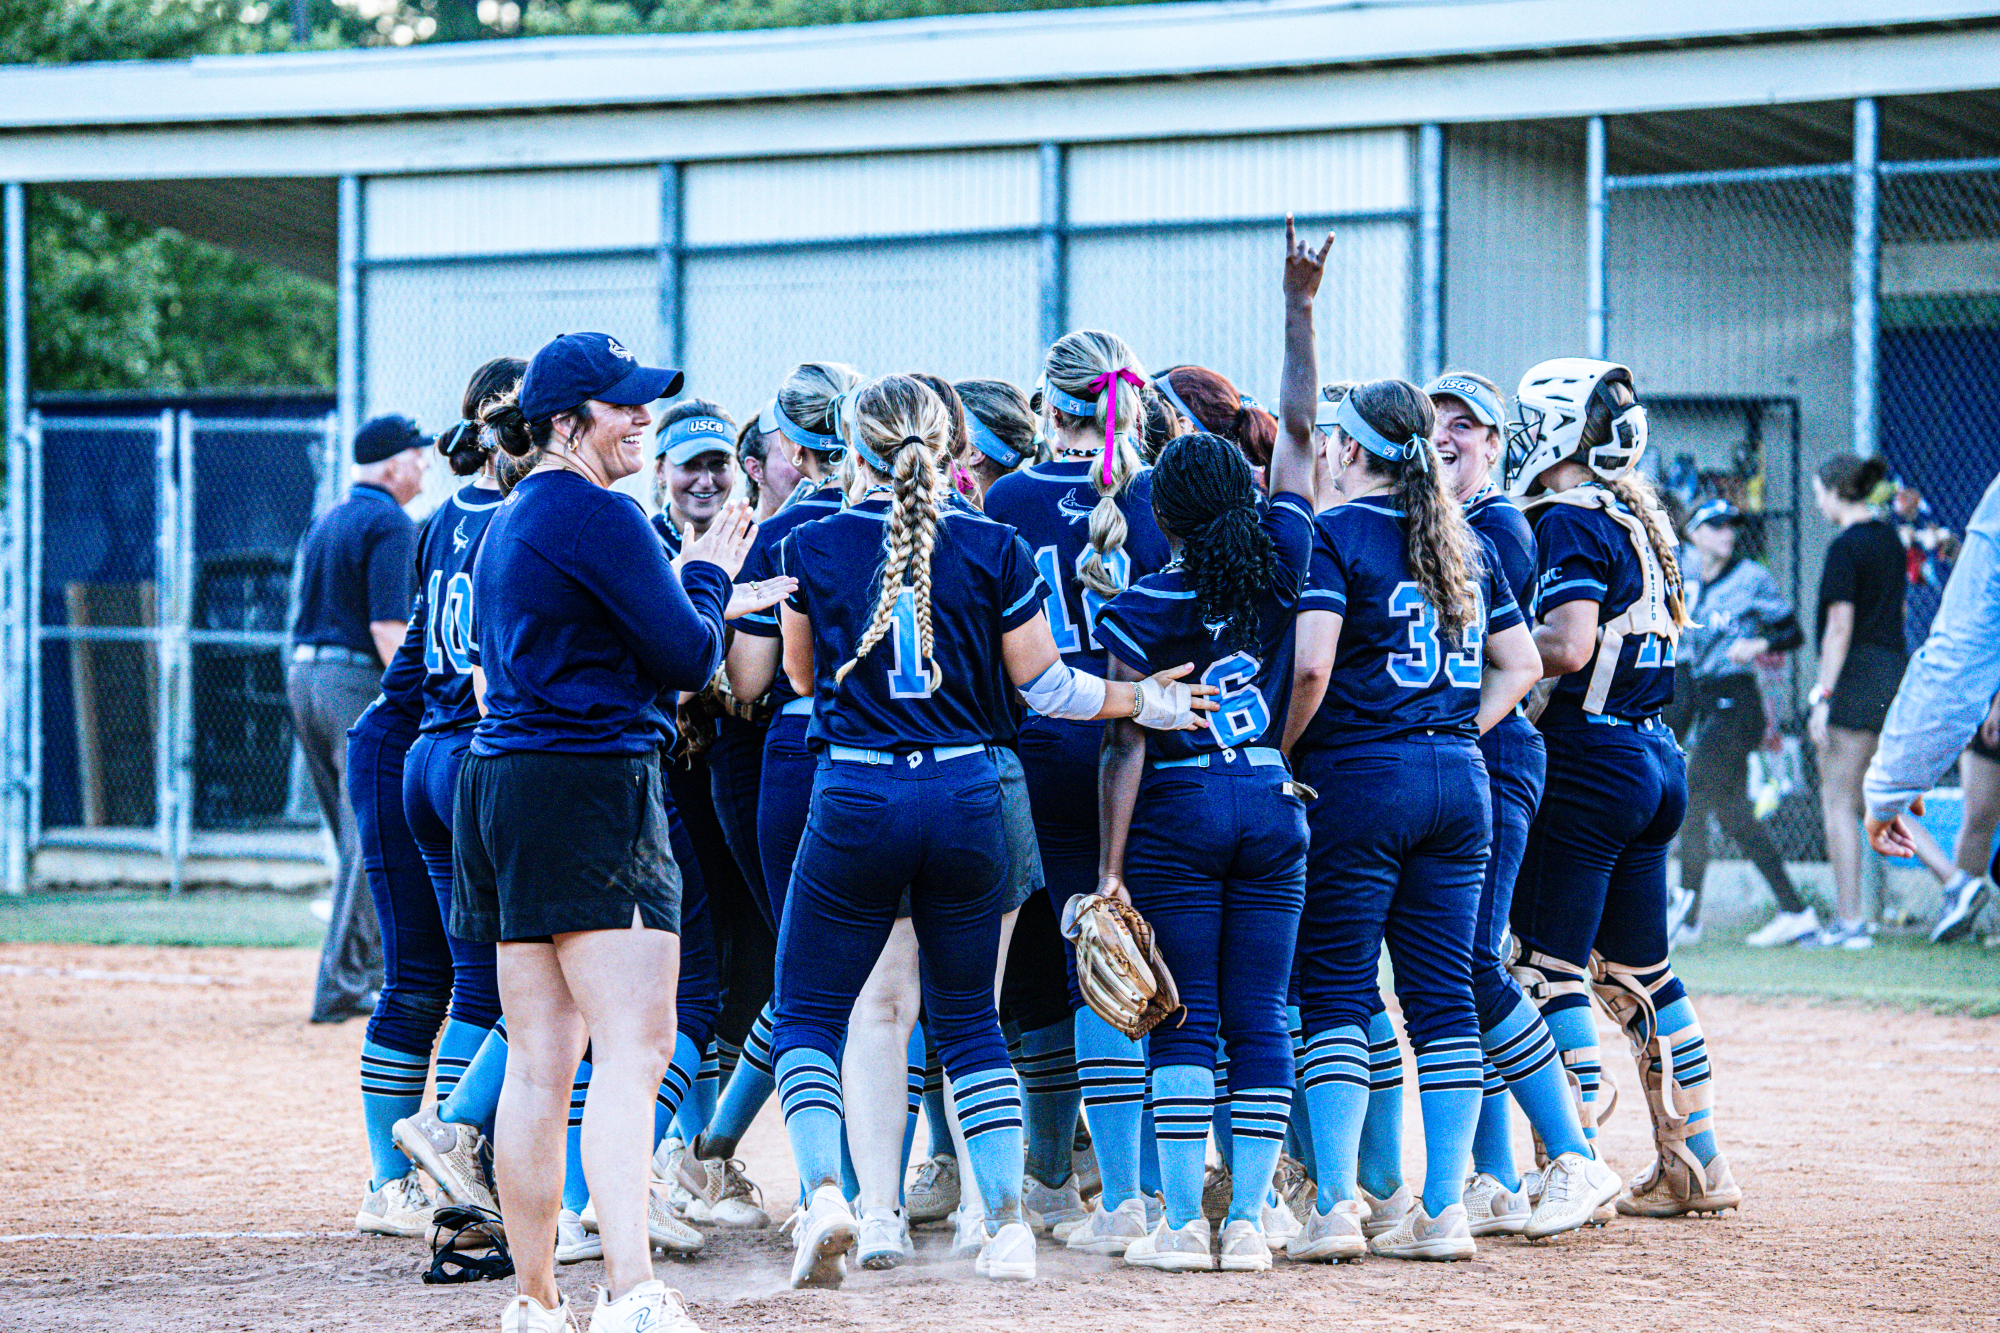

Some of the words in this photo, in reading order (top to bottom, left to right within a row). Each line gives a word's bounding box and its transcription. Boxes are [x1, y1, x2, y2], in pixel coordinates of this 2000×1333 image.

[689, 420, 724, 433] USCB
[1438, 379, 1478, 395] USCB
[424, 569, 474, 675] 10
[886, 586, 932, 699] 1
[1386, 581, 1486, 689] 33
[1200, 649, 1271, 749] 6
